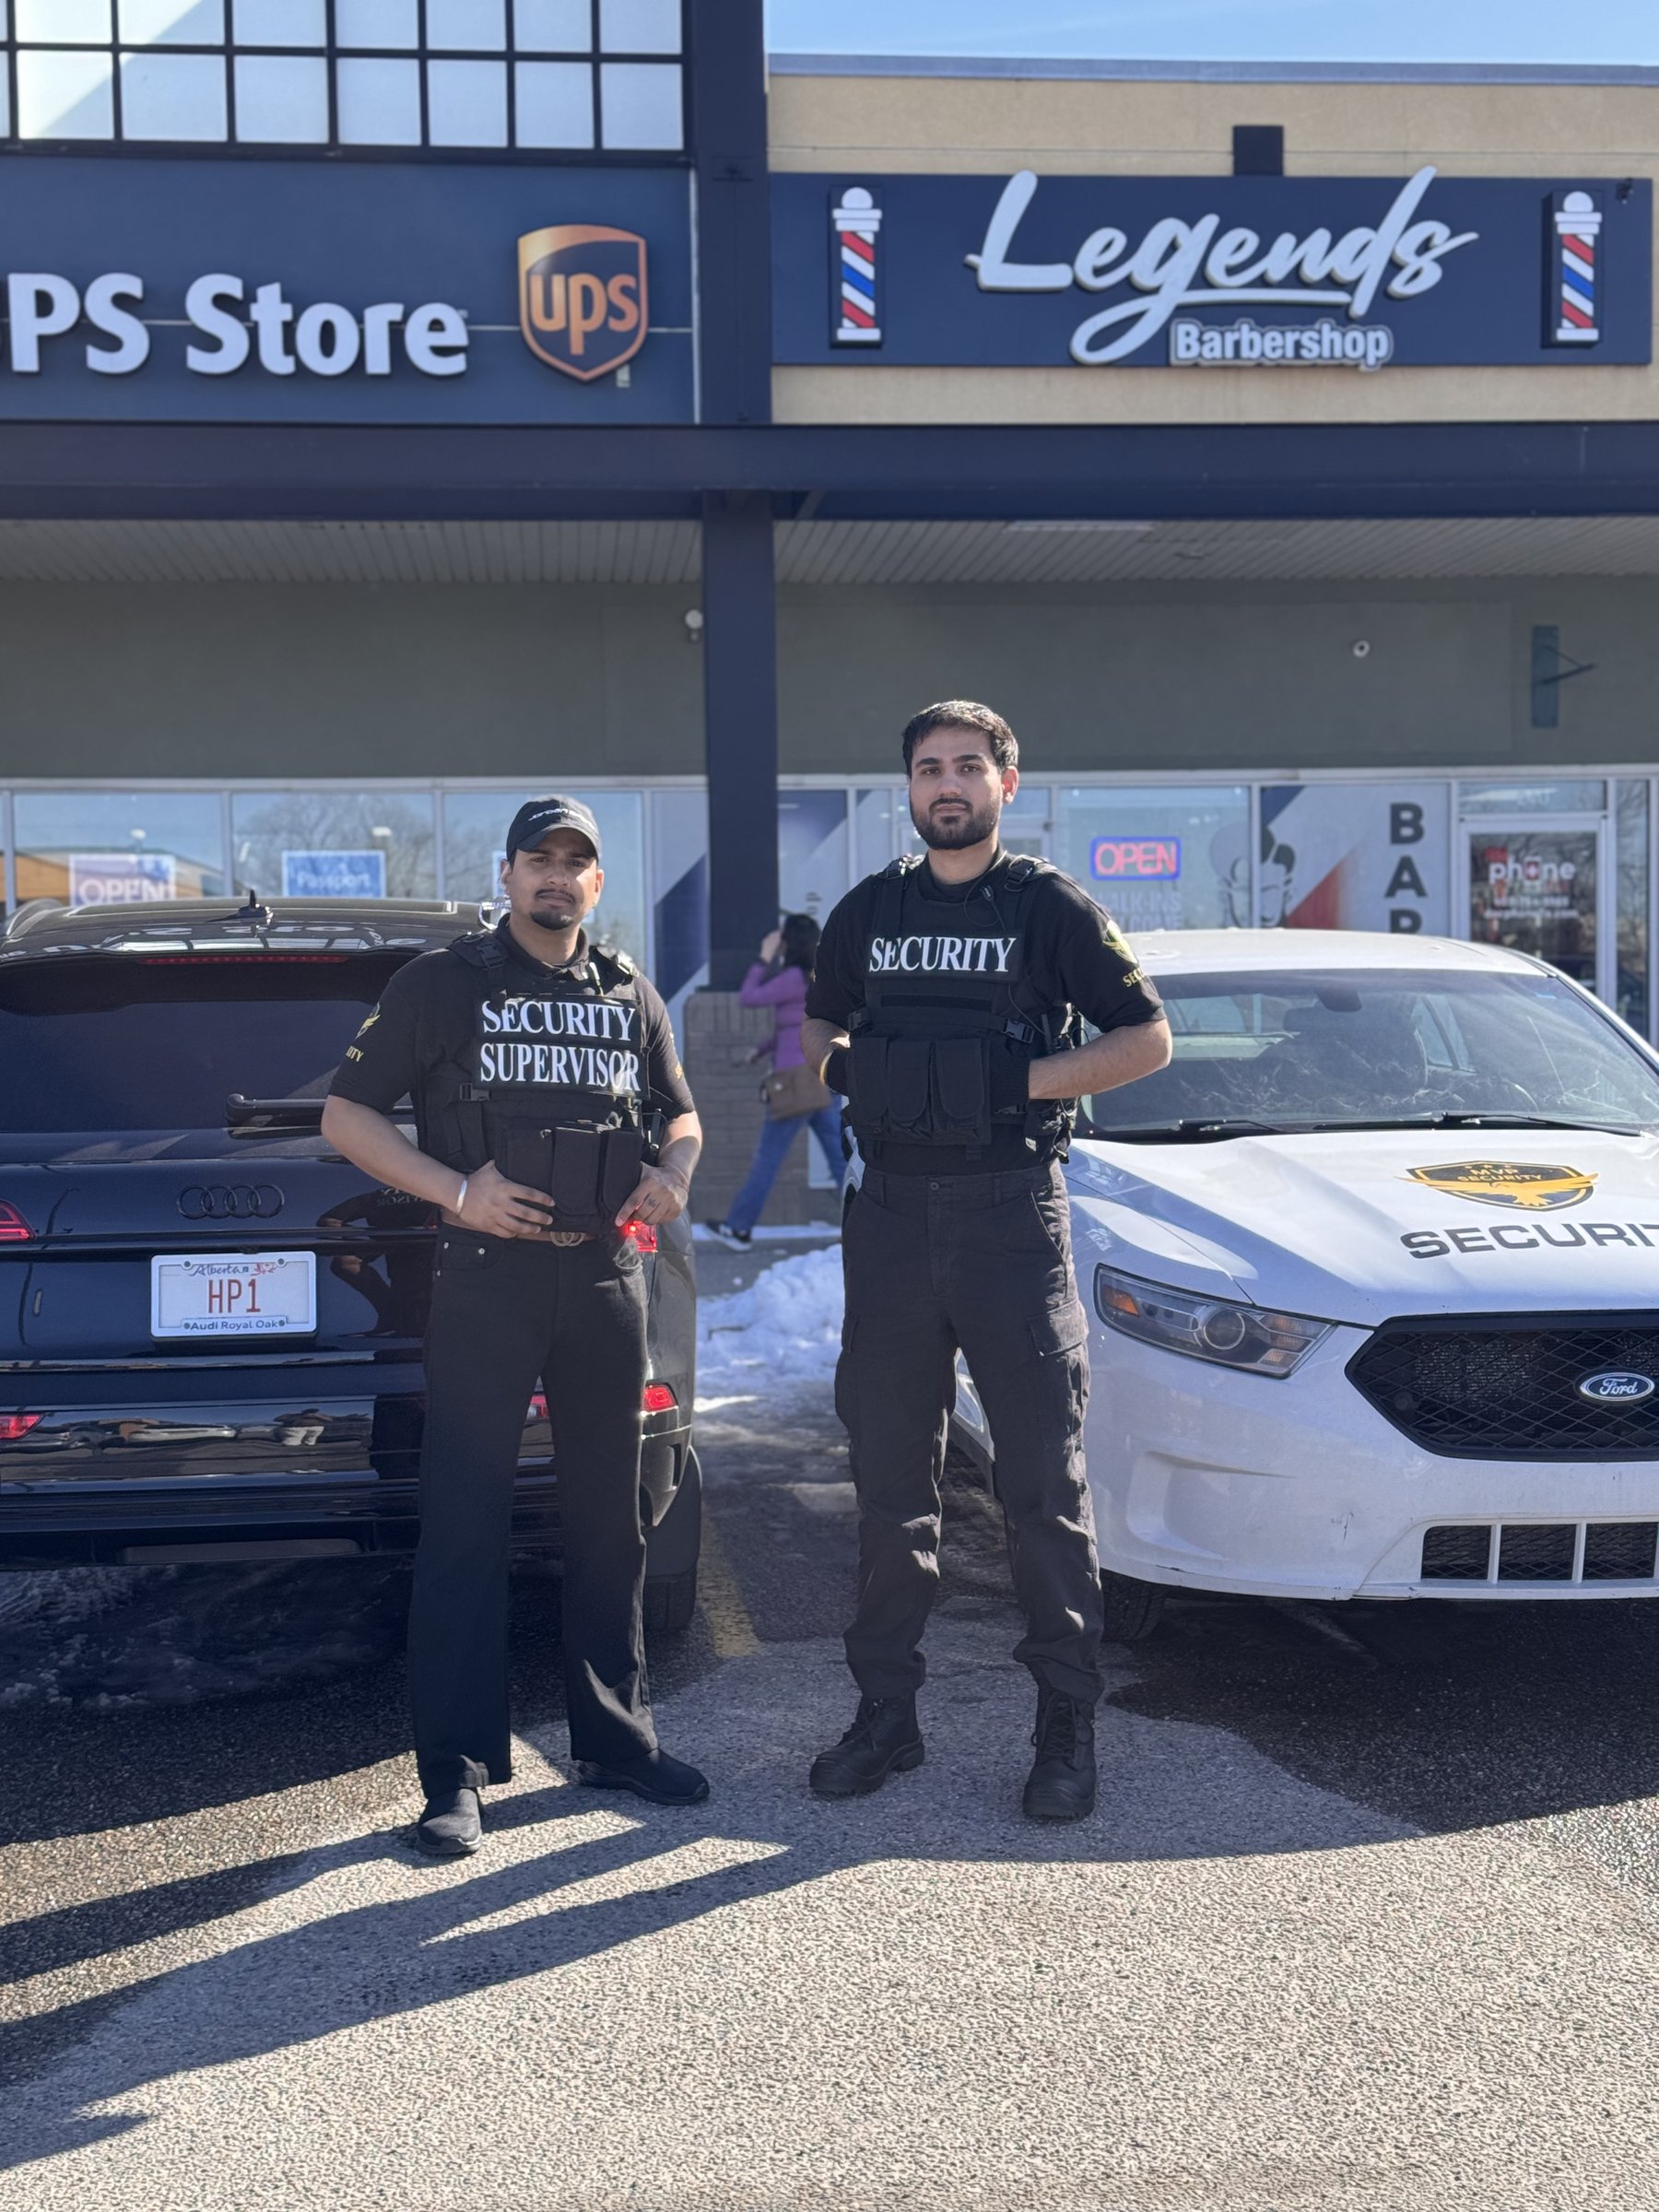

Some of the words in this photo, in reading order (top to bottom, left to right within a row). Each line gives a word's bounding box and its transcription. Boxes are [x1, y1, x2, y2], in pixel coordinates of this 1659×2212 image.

[963, 165, 1480, 366] Legends
[185, 272, 469, 376] Store
[529, 273, 640, 356] ups
[1174, 321, 1392, 369] Barbershop
[1094, 840, 1178, 876] OPEN
[869, 935, 1017, 972] SECURITY
[481, 1000, 636, 1041] SECURITY
[479, 1042, 641, 1092] SUPERVISOR
[1457, 1173, 1542, 1182] SECURITY
[1469, 1168, 1520, 1176] MVP
[189, 1264, 240, 1276] Alberta
[207, 1278, 262, 1313] HP1
[190, 1321, 218, 1330] Audi
[221, 1320, 253, 1331] Royal
[255, 1319, 278, 1329] Oak
[1598, 1377, 1639, 1395] Ford
